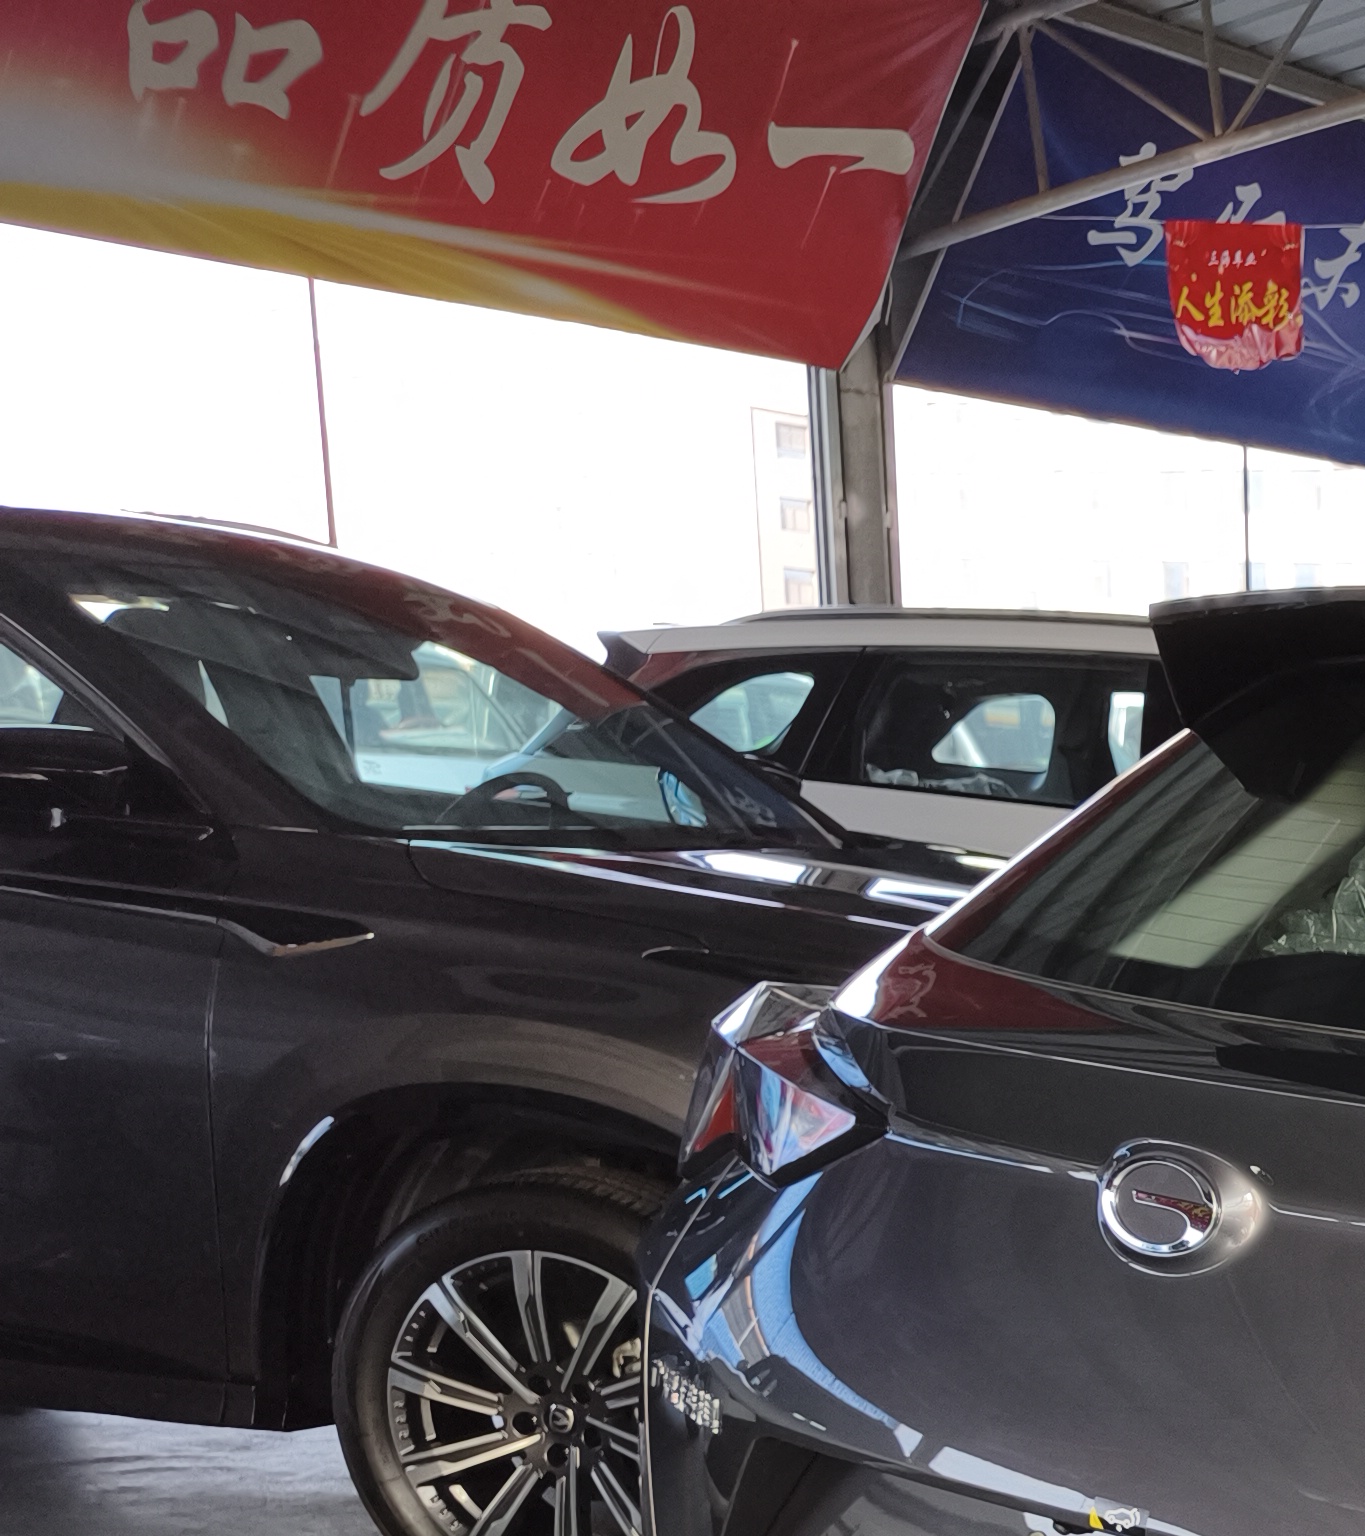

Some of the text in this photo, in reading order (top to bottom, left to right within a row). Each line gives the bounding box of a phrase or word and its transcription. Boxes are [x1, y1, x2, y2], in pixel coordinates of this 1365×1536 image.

[128, 0, 916, 204] 品质如一
[1175, 279, 1292, 332] 人生添彩
